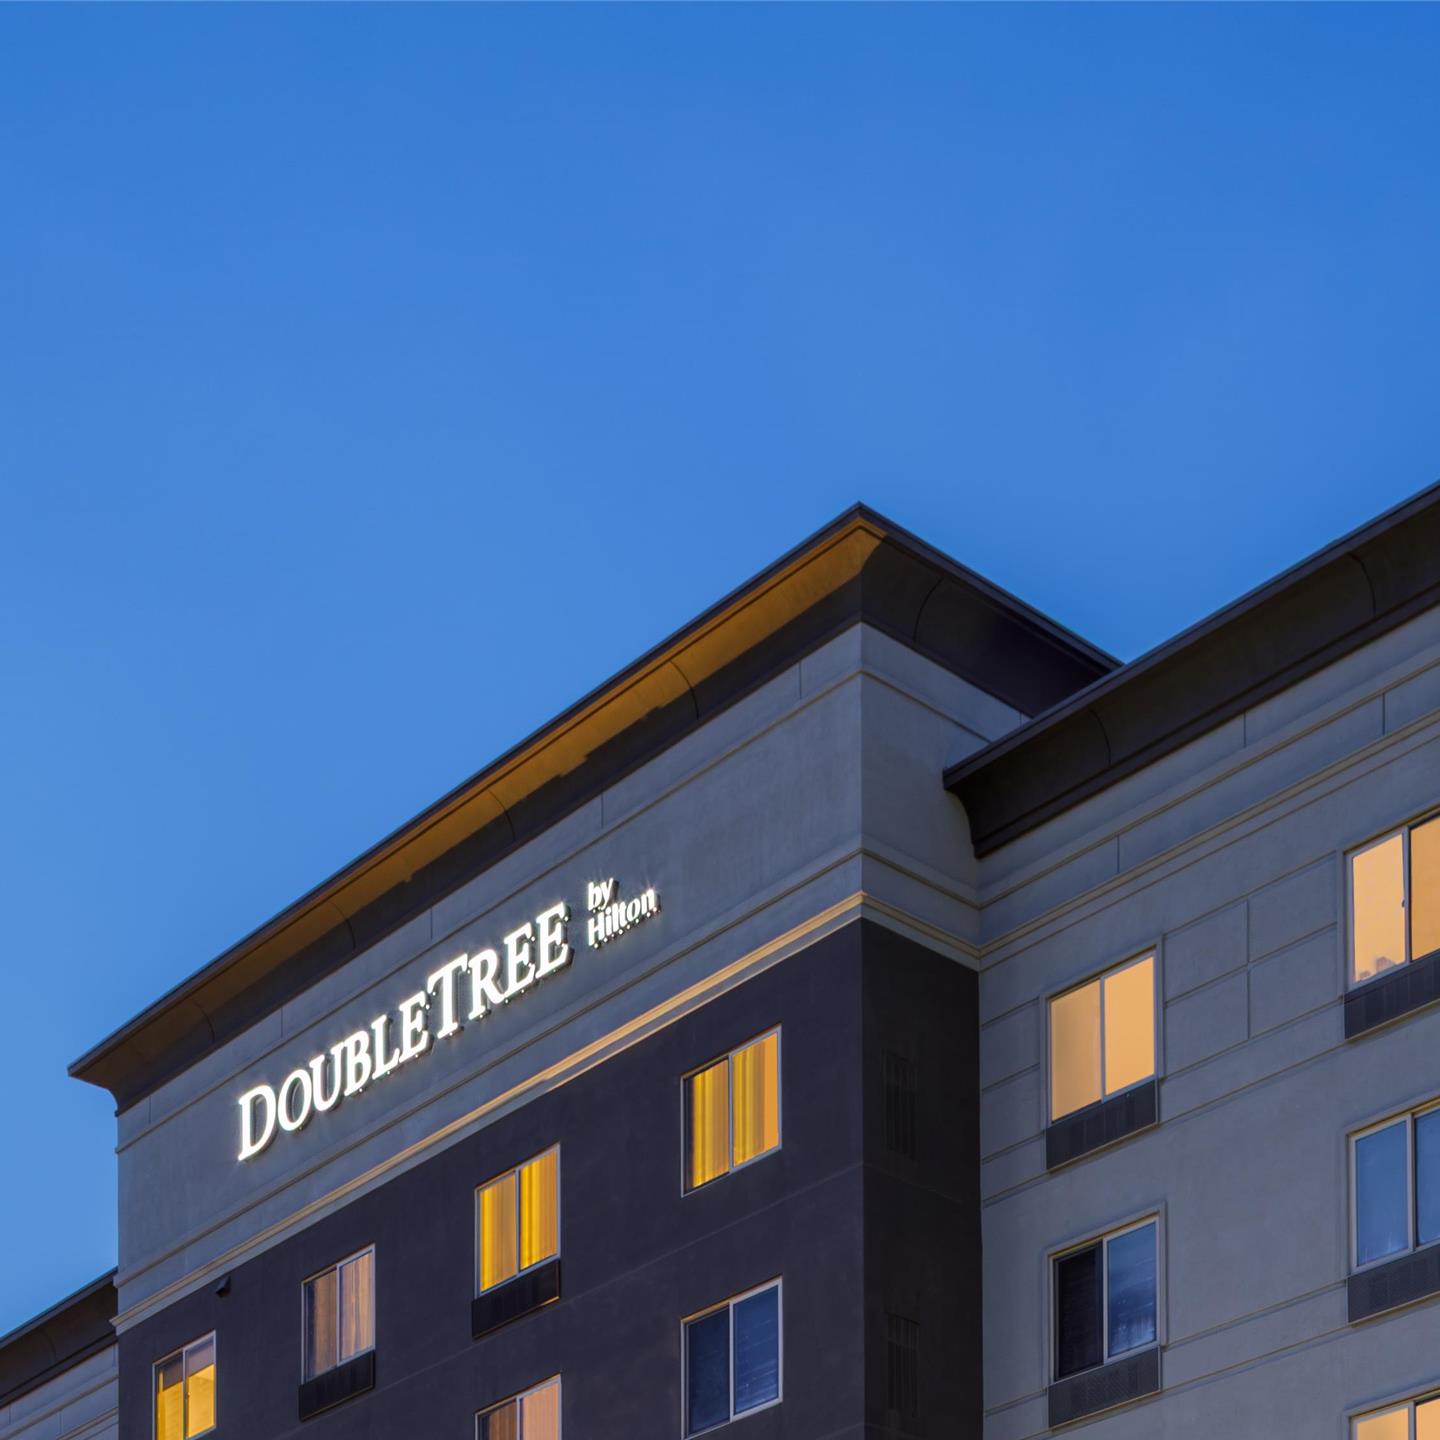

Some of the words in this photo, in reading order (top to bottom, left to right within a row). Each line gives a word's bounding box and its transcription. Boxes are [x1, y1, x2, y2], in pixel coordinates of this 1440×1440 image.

[587, 877, 614, 912] by
[587, 888, 658, 947] Hilton
[237, 901, 570, 1161] DOUBLETREE
